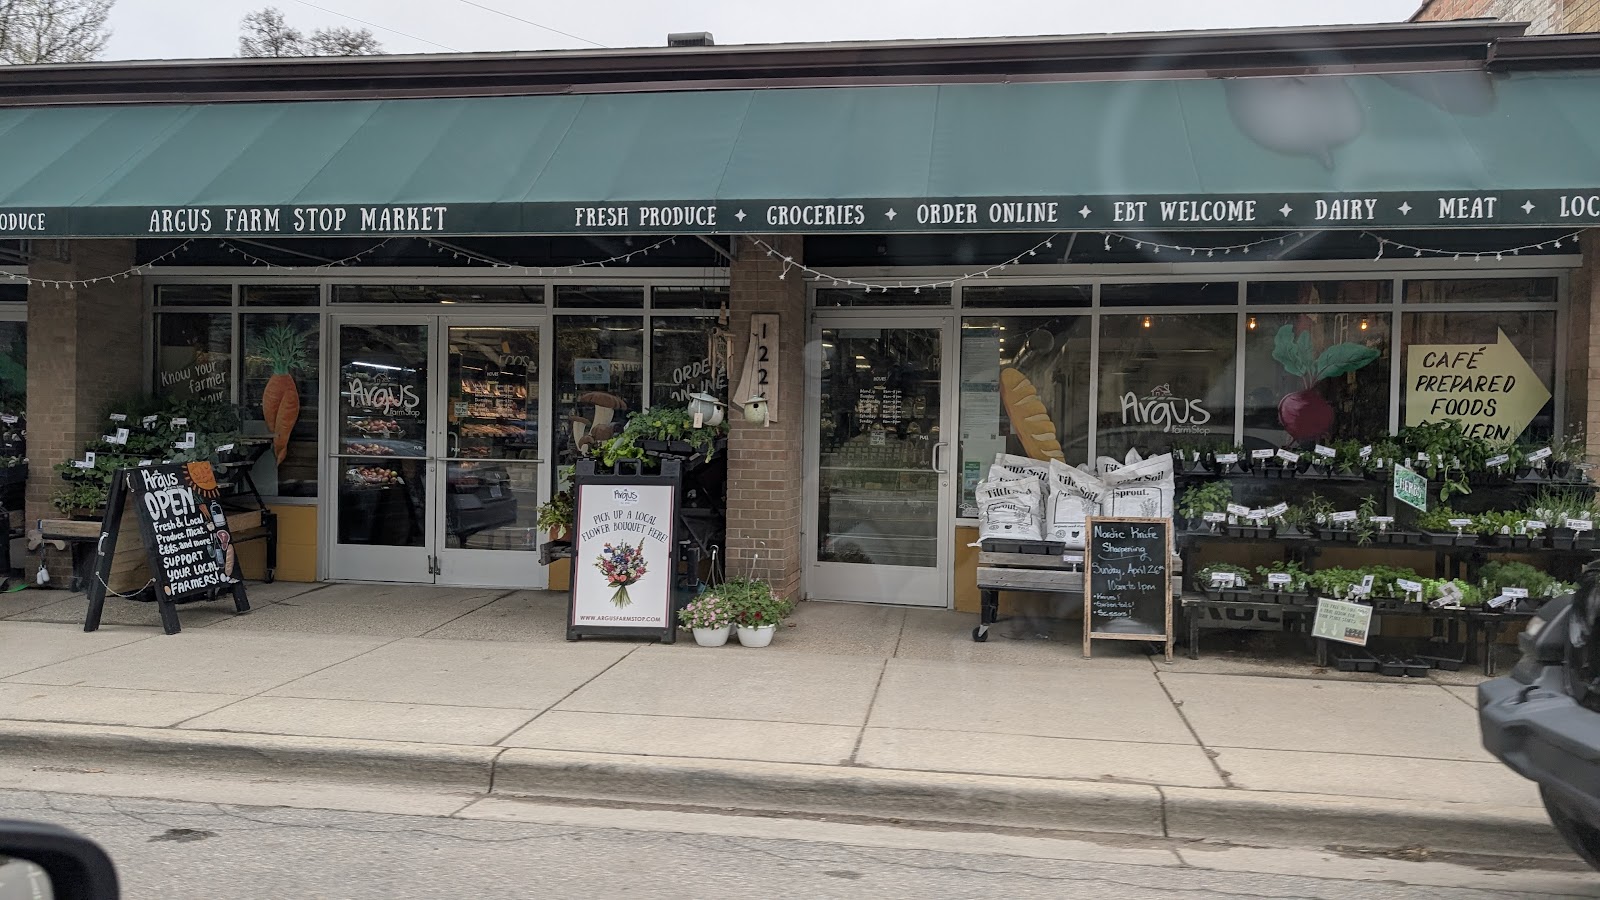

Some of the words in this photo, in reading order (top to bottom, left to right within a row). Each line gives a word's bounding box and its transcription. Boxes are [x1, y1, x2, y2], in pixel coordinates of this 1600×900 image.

[574, 207, 629, 227] FRESH
[639, 206, 717, 226] PRODUCE
[766, 205, 865, 226] GROCERIES
[916, 204, 978, 224] ORDER
[989, 202, 1059, 223] ONLINE
[1112, 201, 1148, 222] EBT
[1159, 201, 1257, 222] WELCOME
[1314, 199, 1378, 221] DAIRY
[1437, 197, 1498, 219] MEAT
[1559, 195, 1600, 218] LOC
[148, 208, 212, 232] ARGUS
[224, 208, 281, 232] FARM
[293, 207, 347, 232] STOP
[360, 207, 448, 231] MARKET
[758, 323, 769, 404] 122
[1422, 346, 1487, 370] CAFÉ
[161, 367, 191, 387] Know
[673, 358, 720, 384] ORDE
[189, 371, 226, 394] farmer
[1415, 375, 1516, 393] PREPARED
[348, 378, 420, 415] Argus
[1430, 398, 1497, 417] FOODS
[1120, 391, 1211, 433] Argus
[141, 469, 179, 491] Argus
[144, 487, 196, 520] OPEN
[1115, 489, 1150, 499] sprout.
[153, 519, 176, 533] Fresh
[175, 516, 185, 528] &
[184, 513, 204, 527] Local
[593, 511, 611, 525] PICK
[613, 510, 624, 520] UP
[626, 510, 632, 519] A
[635, 511, 657, 526] LOCAL
[179, 539, 193, 550] and
[193, 533, 213, 548] more!
[581, 523, 611, 542] FLOWER
[613, 521, 647, 534] BOUQUET
[647, 527, 669, 544] HERE!
[1094, 525, 1126, 539] Nordic
[1130, 526, 1159, 539] Knife
[163, 550, 204, 569] SUPPORT
[1127, 563, 1146, 577] April
[166, 567, 192, 582] YOUR
[193, 561, 220, 576] LOCAL
[171, 572, 220, 596] FARMERS!
